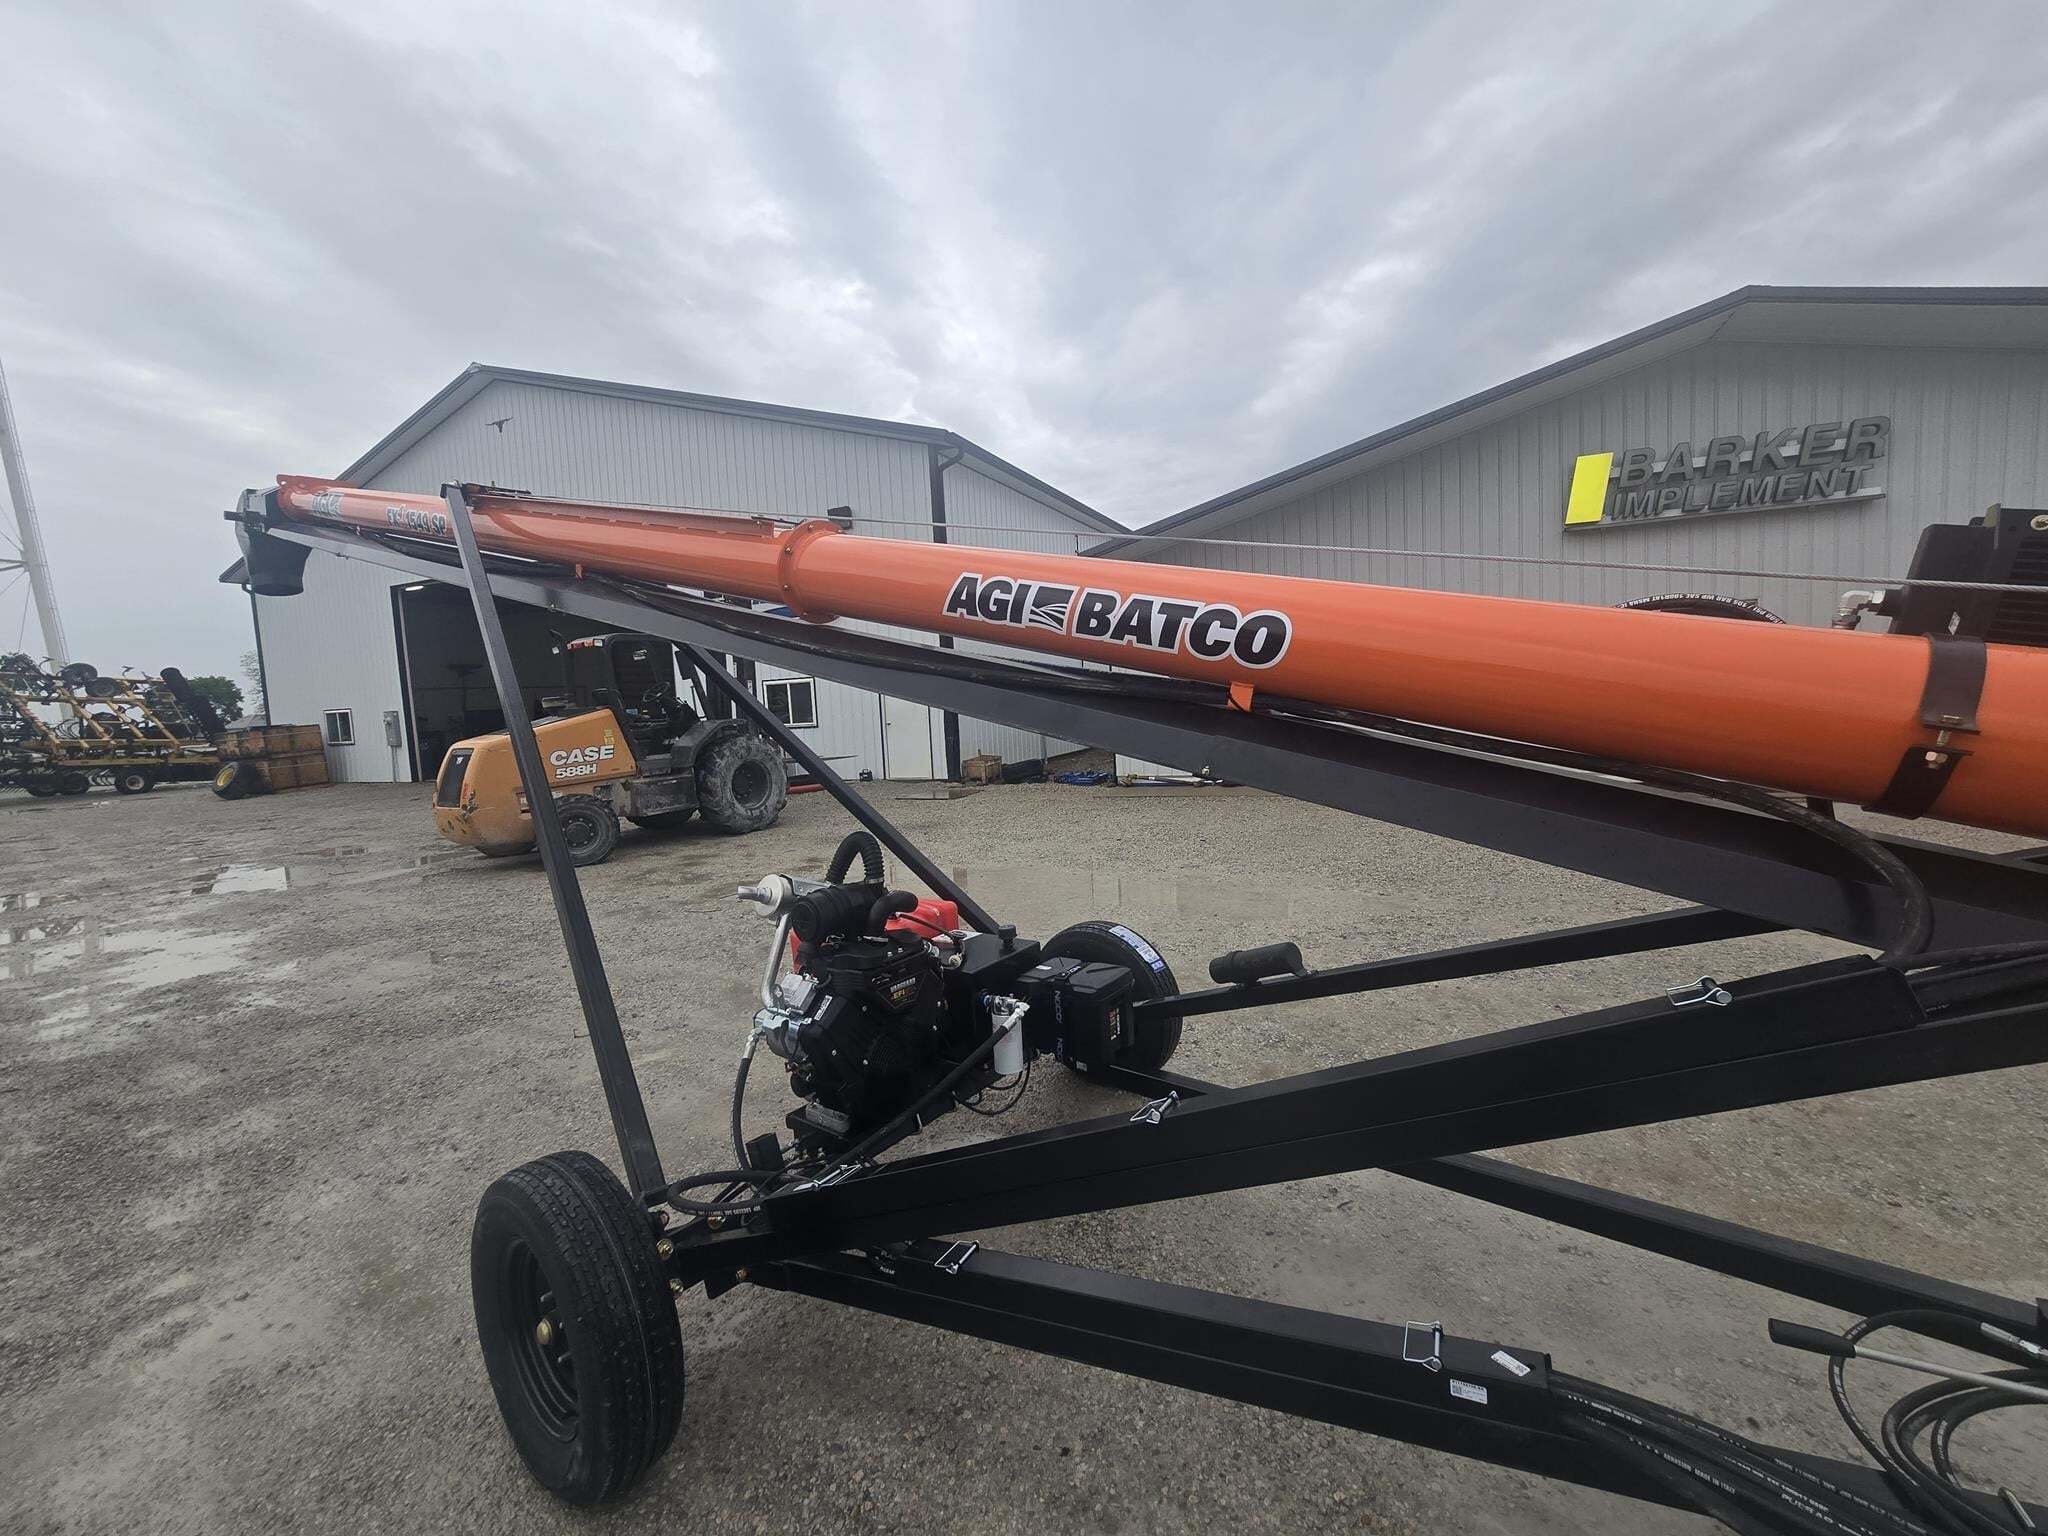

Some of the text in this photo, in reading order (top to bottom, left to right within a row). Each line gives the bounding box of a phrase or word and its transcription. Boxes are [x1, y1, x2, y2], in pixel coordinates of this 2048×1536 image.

[1618, 416, 1891, 488] BARKER
[1612, 464, 1874, 519] IMPLEMENT
[943, 572, 1292, 669] AGI BATCO
[550, 745, 614, 766] CASE
[555, 764, 597, 779] 588H
